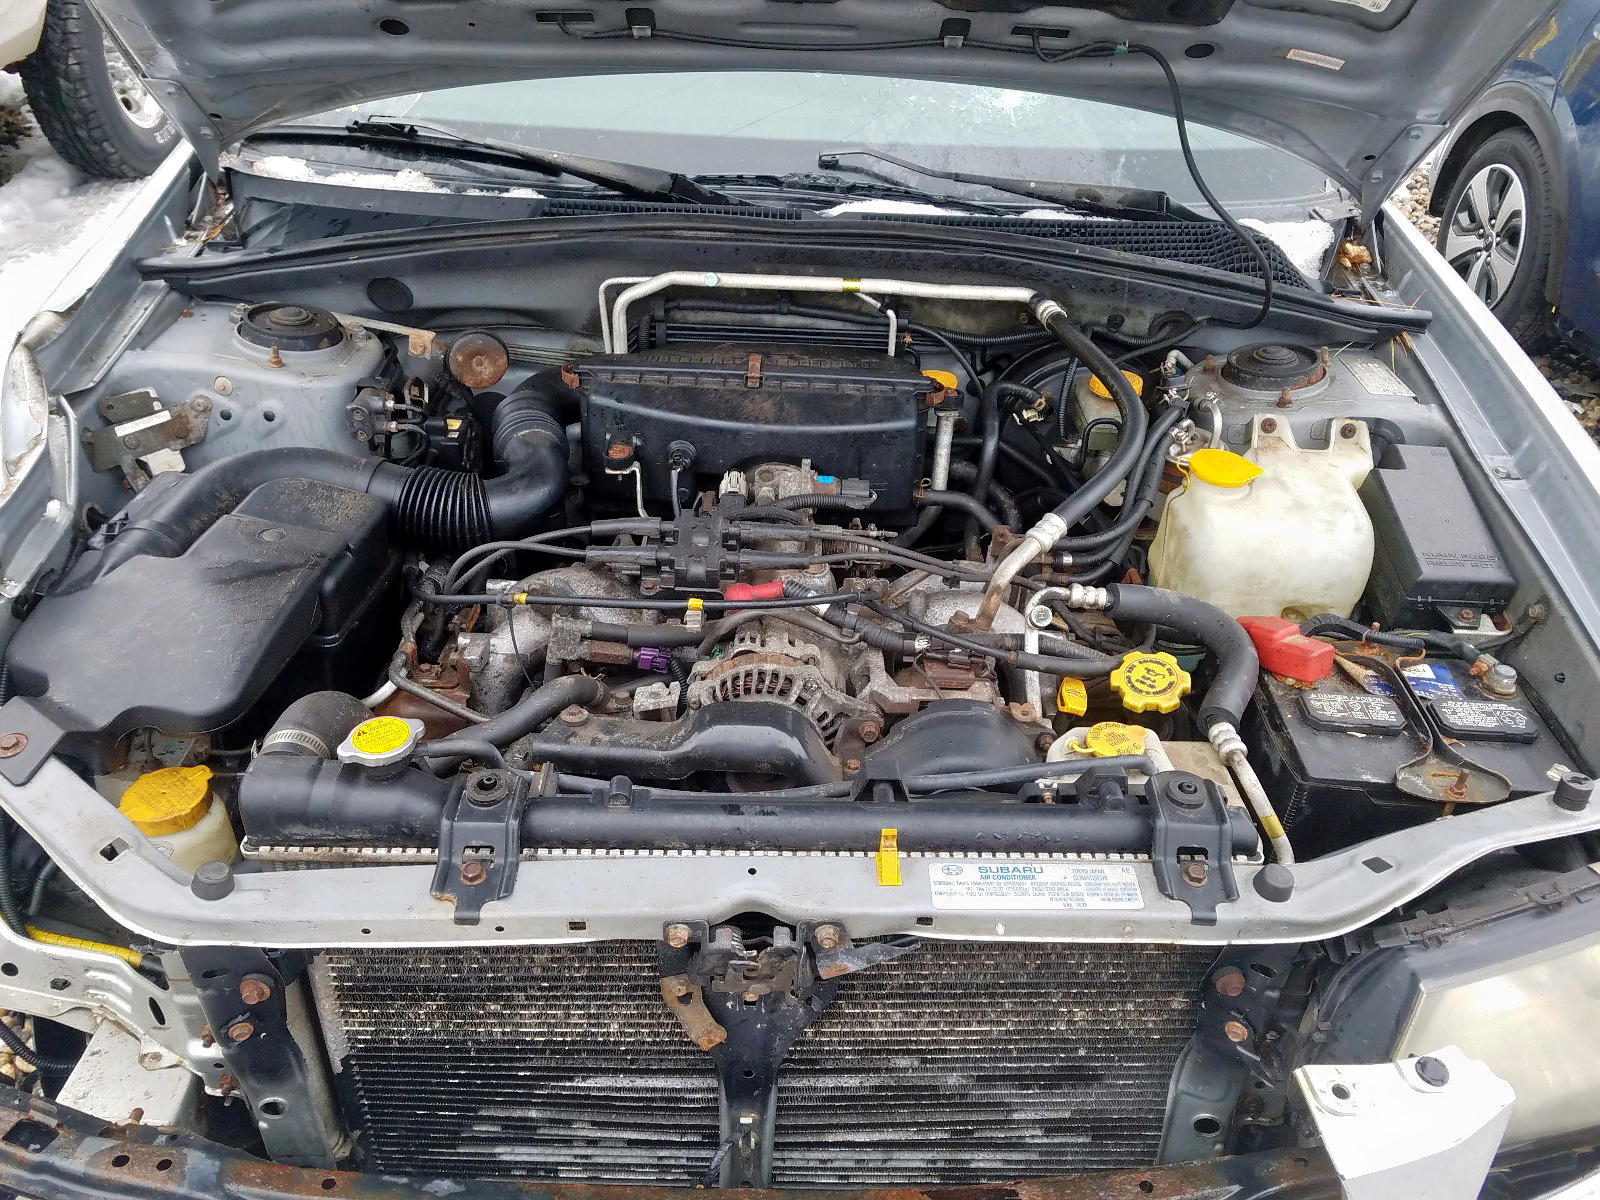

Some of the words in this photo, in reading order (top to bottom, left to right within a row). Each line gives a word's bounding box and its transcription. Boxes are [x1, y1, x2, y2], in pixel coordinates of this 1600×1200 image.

[1421, 551, 1458, 559] MAIN
[1460, 552, 1496, 561] FUSE
[1426, 560, 1464, 568] RELAY
[1317, 693, 1348, 701] DANGER
[978, 866, 1043, 874] SUBARU
